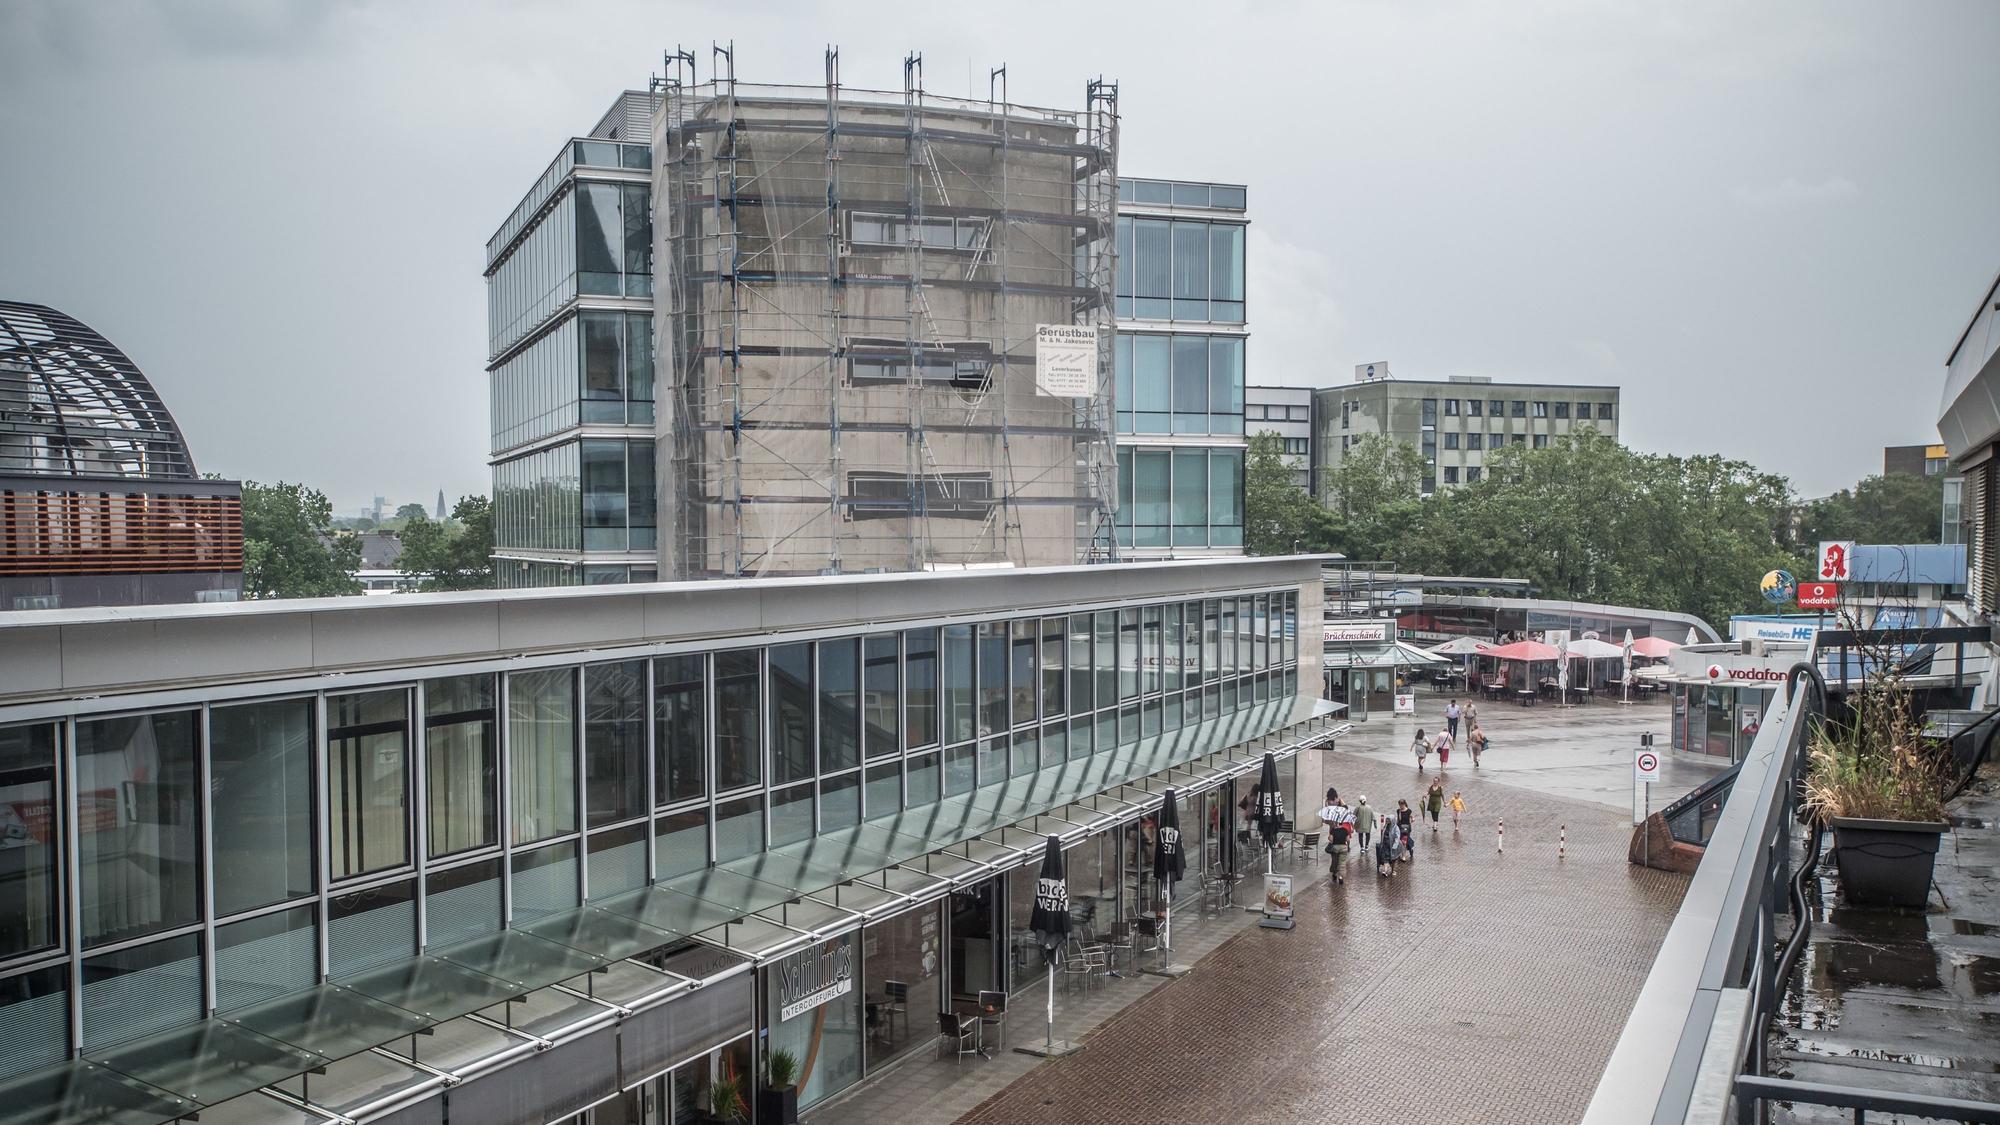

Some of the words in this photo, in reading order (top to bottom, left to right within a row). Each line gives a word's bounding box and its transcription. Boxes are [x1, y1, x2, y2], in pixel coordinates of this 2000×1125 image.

[1039, 327, 1095, 338] Gerüstbau
[1323, 629, 1382, 641] Brückenschänke
[1757, 629, 1790, 639] Reisebüro
[1791, 628, 1813, 640] HE
[1728, 667, 1789, 681] vodafon
[782, 988, 836, 1018] INTERCOIFFURE
